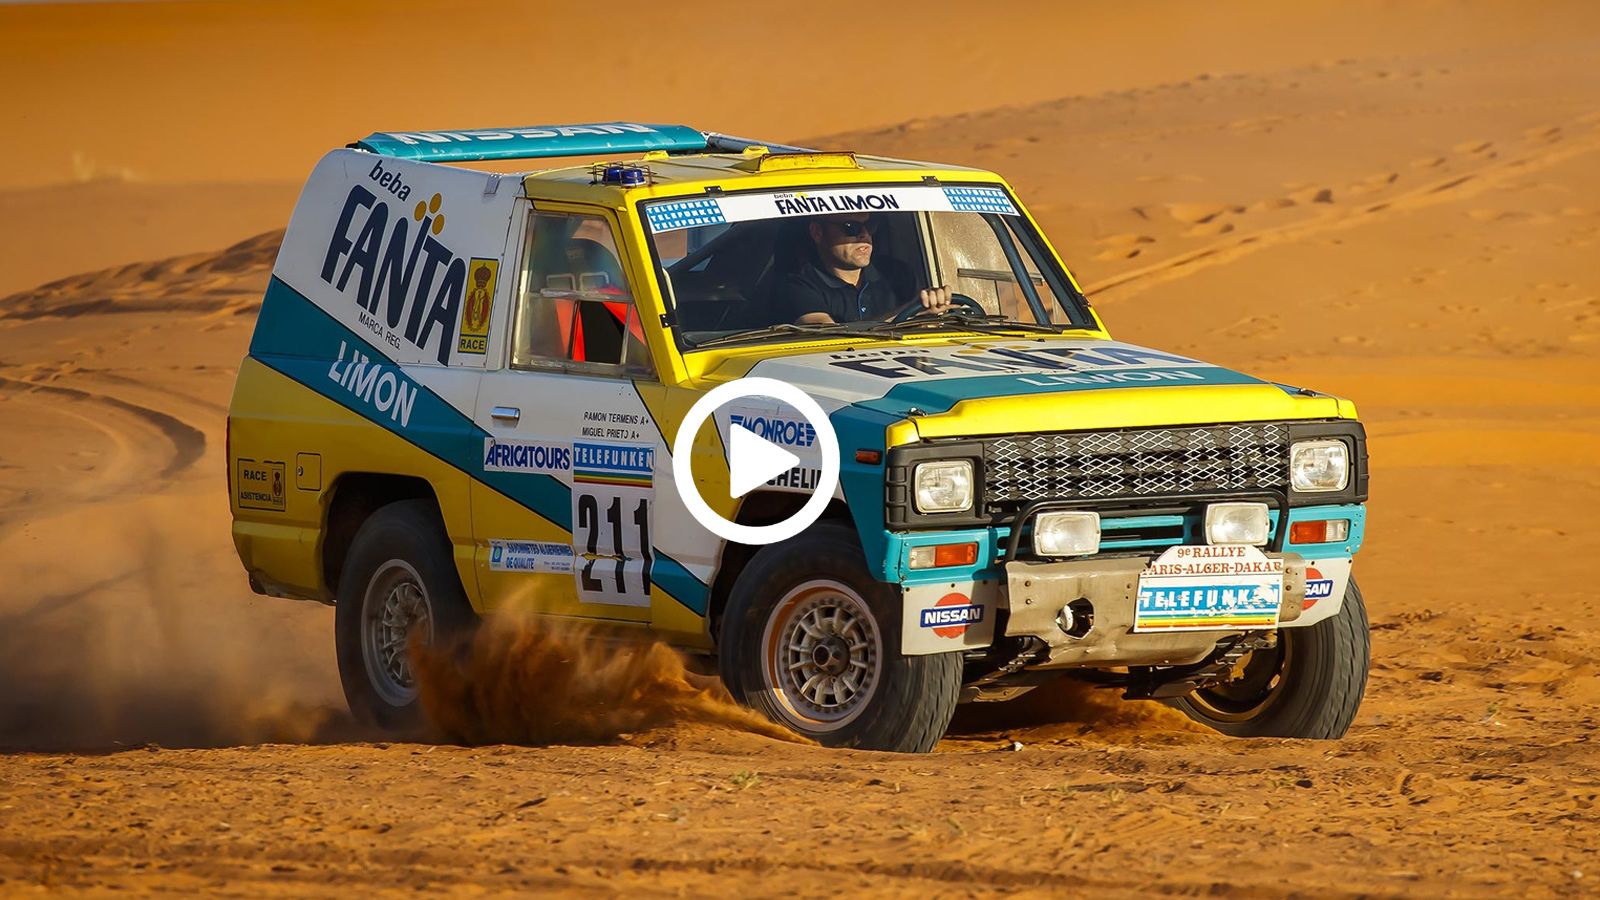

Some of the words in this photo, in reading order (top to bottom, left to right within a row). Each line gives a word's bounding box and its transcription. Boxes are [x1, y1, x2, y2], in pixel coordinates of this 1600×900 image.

[390, 123, 658, 145] NISSAN
[369, 159, 411, 202] beba
[775, 196, 832, 215] FANTA
[829, 194, 900, 211] LIMON
[320, 184, 467, 368] FANTA
[358, 311, 384, 340] MARCA
[460, 338, 485, 350] RACE
[829, 347, 1203, 378] FANTA
[327, 339, 418, 428] LIMON
[1016, 370, 1205, 386] LIMON
[608, 413, 638, 424] TERMENS
[582, 426, 605, 437] MIGUEL
[485, 444, 571, 471] AFRICATOURS
[574, 446, 655, 468] TELEFUNKEN
[243, 469, 267, 481] RACE
[578, 494, 651, 596] 211
[1192, 546, 1246, 558] RALLYE
[924, 607, 981, 624] NISSAN
